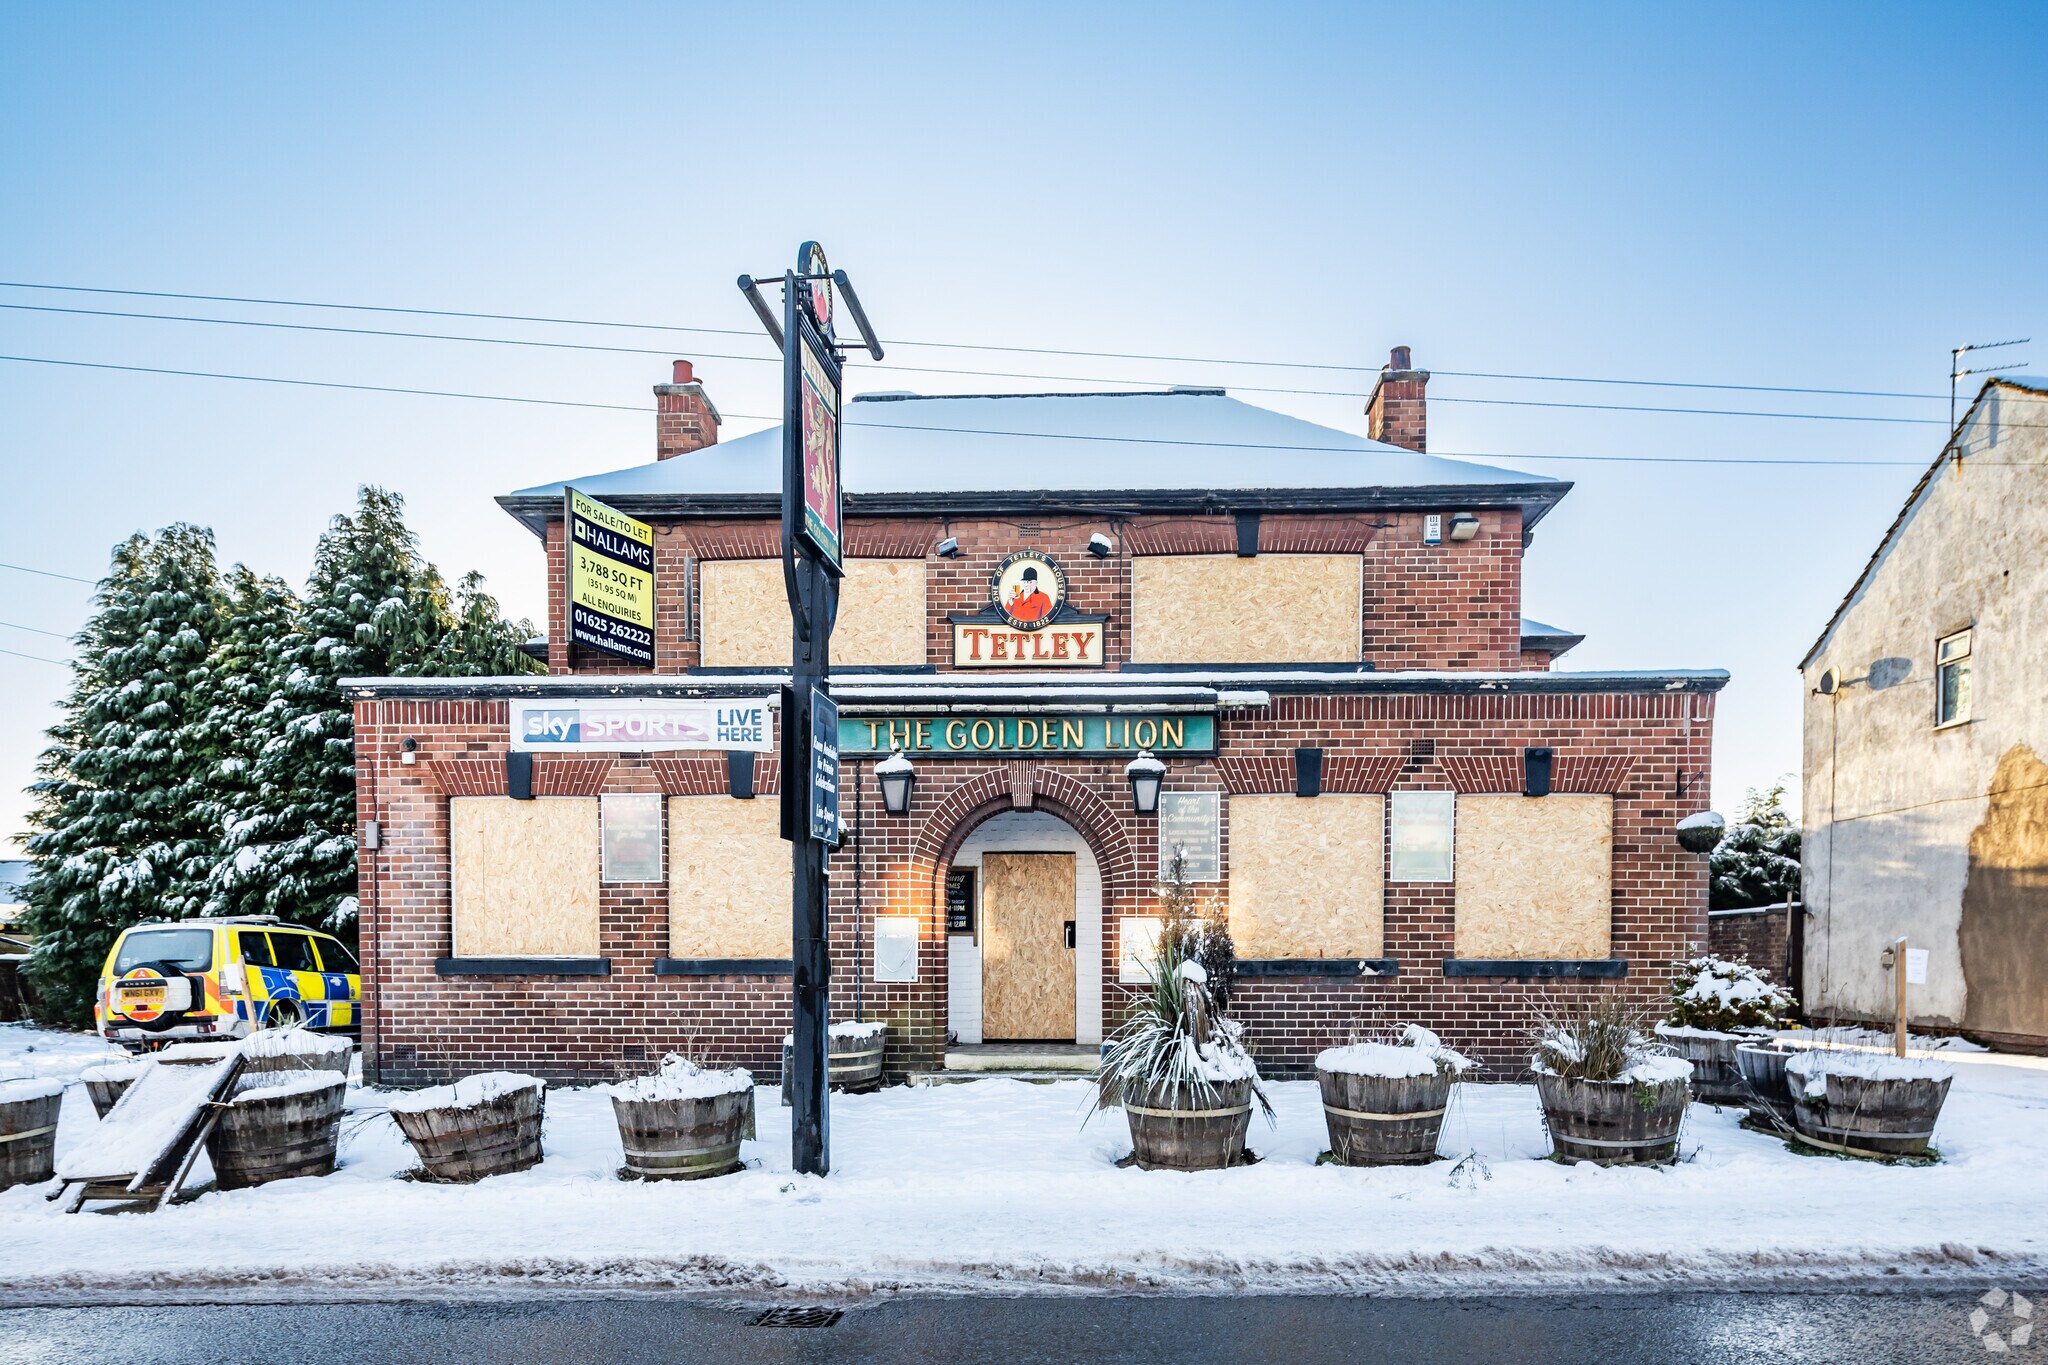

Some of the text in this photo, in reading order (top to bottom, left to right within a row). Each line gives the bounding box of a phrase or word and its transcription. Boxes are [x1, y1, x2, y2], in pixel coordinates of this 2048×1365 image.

[576, 498, 648, 540] FOR SALE/TO LET
[587, 525, 650, 566] HALLAMS
[580, 556, 643, 591] 3,788 SQ FT
[996, 566, 1004, 576] OF
[1008, 552, 1046, 562] TETLEY'S
[1052, 566, 1064, 600] HOUSES
[588, 578, 637, 604] (351.95 SQ M)
[582, 592, 642, 621] ALL ENQUIRIES
[575, 609, 651, 646] 01625 262222
[1032, 617, 1050, 628] 1822
[575, 629, 651, 660] www.hallams.com
[963, 628, 1096, 660] TETLEY
[528, 711, 705, 741] sky SPORTS
[717, 709, 762, 726] LIVE
[717, 728, 762, 742] HERE
[864, 718, 1184, 750] THE GOLDEN LION
[823, 758, 834, 776] Private
[816, 772, 836, 794] Celebrations
[1178, 796, 1200, 805] Heart
[1168, 814, 1210, 826] Community
